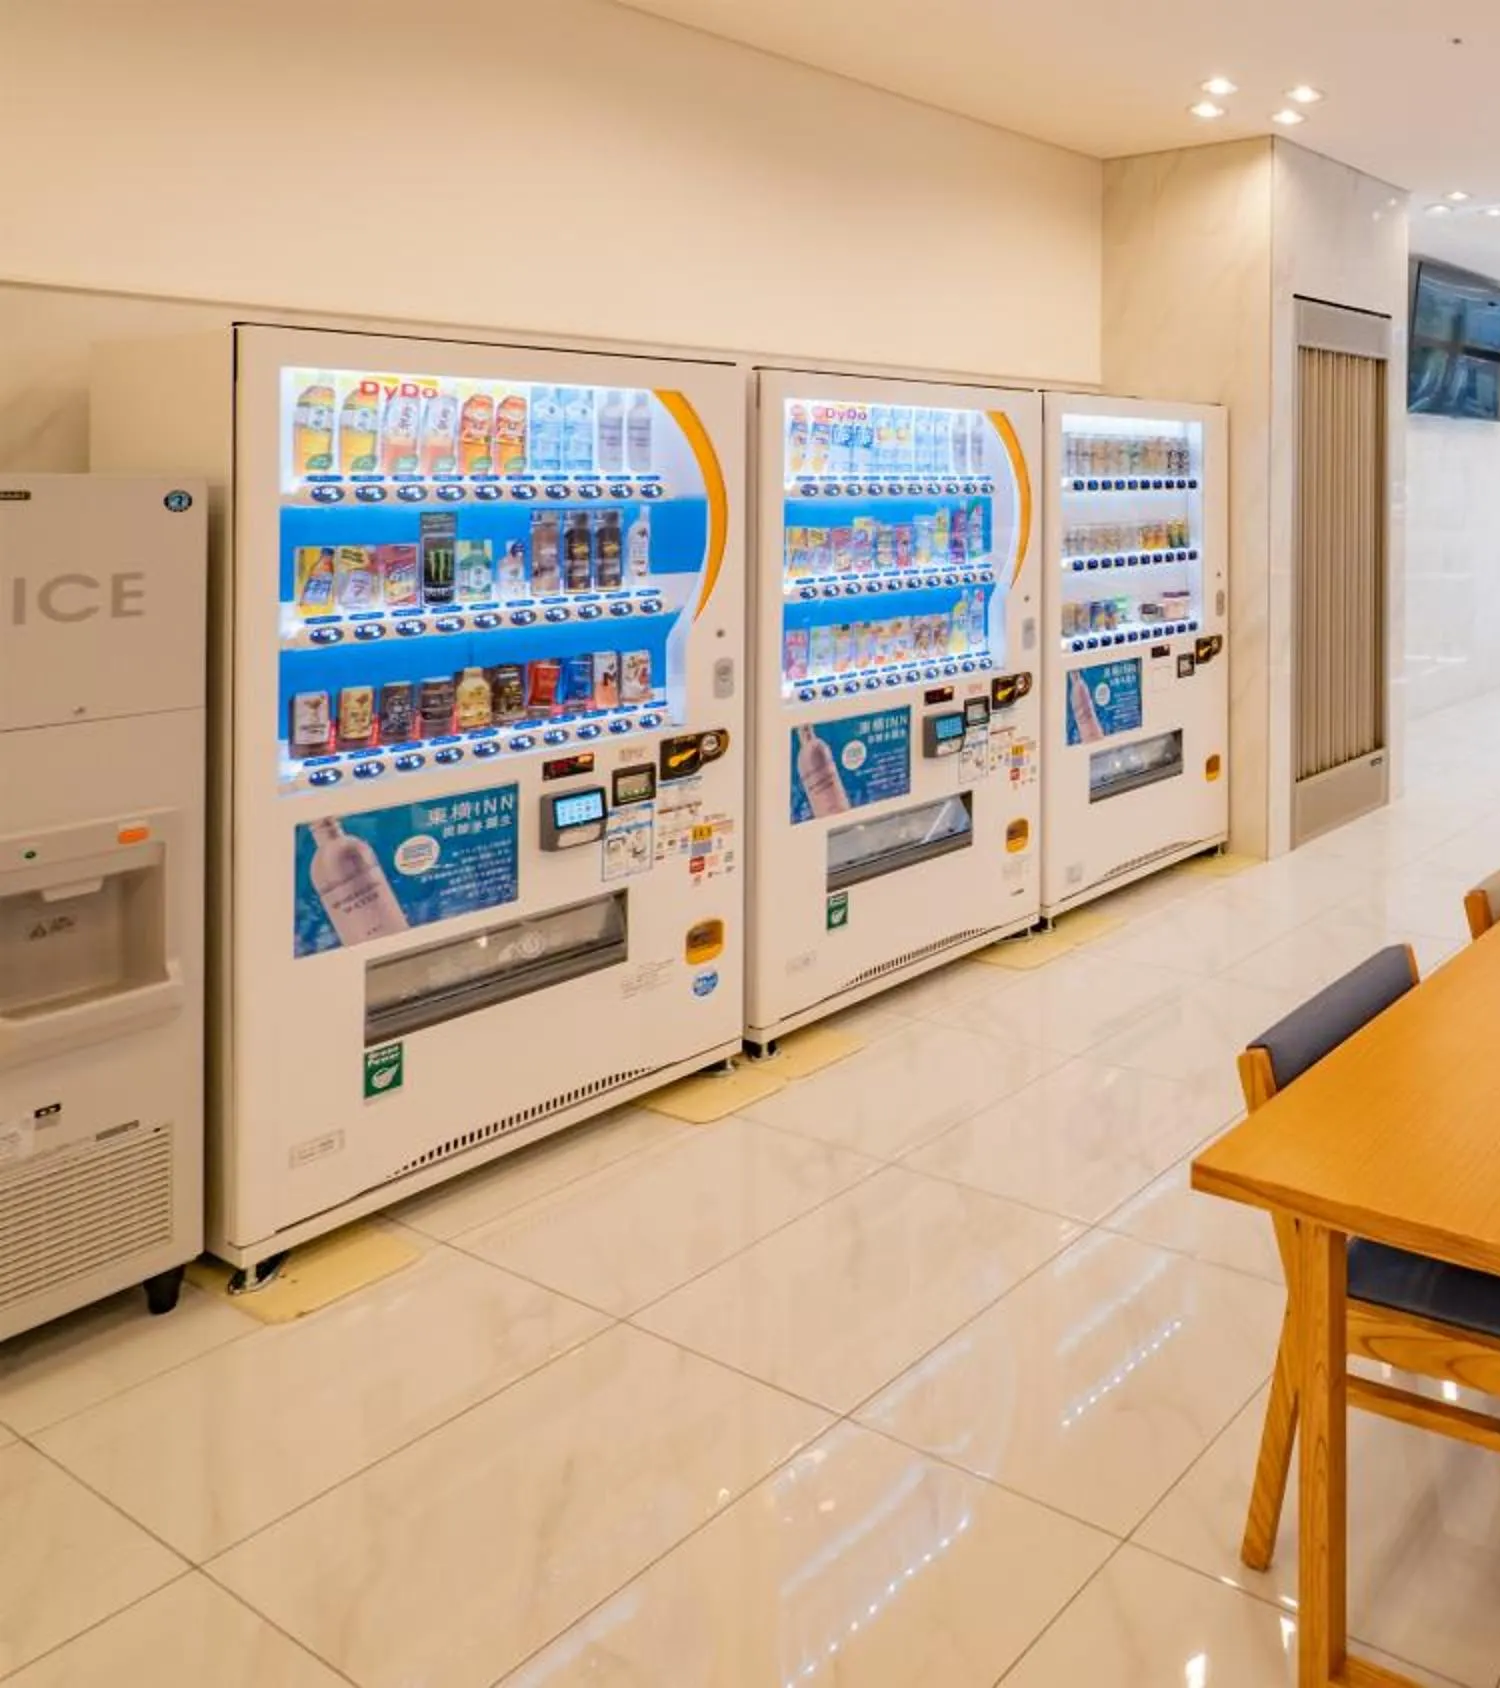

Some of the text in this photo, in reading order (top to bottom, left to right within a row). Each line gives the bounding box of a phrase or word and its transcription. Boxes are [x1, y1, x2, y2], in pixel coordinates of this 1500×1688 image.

[359, 380, 438, 402] DyDo
[825, 407, 867, 421] DyDo
[13, 572, 145, 625] ICE
